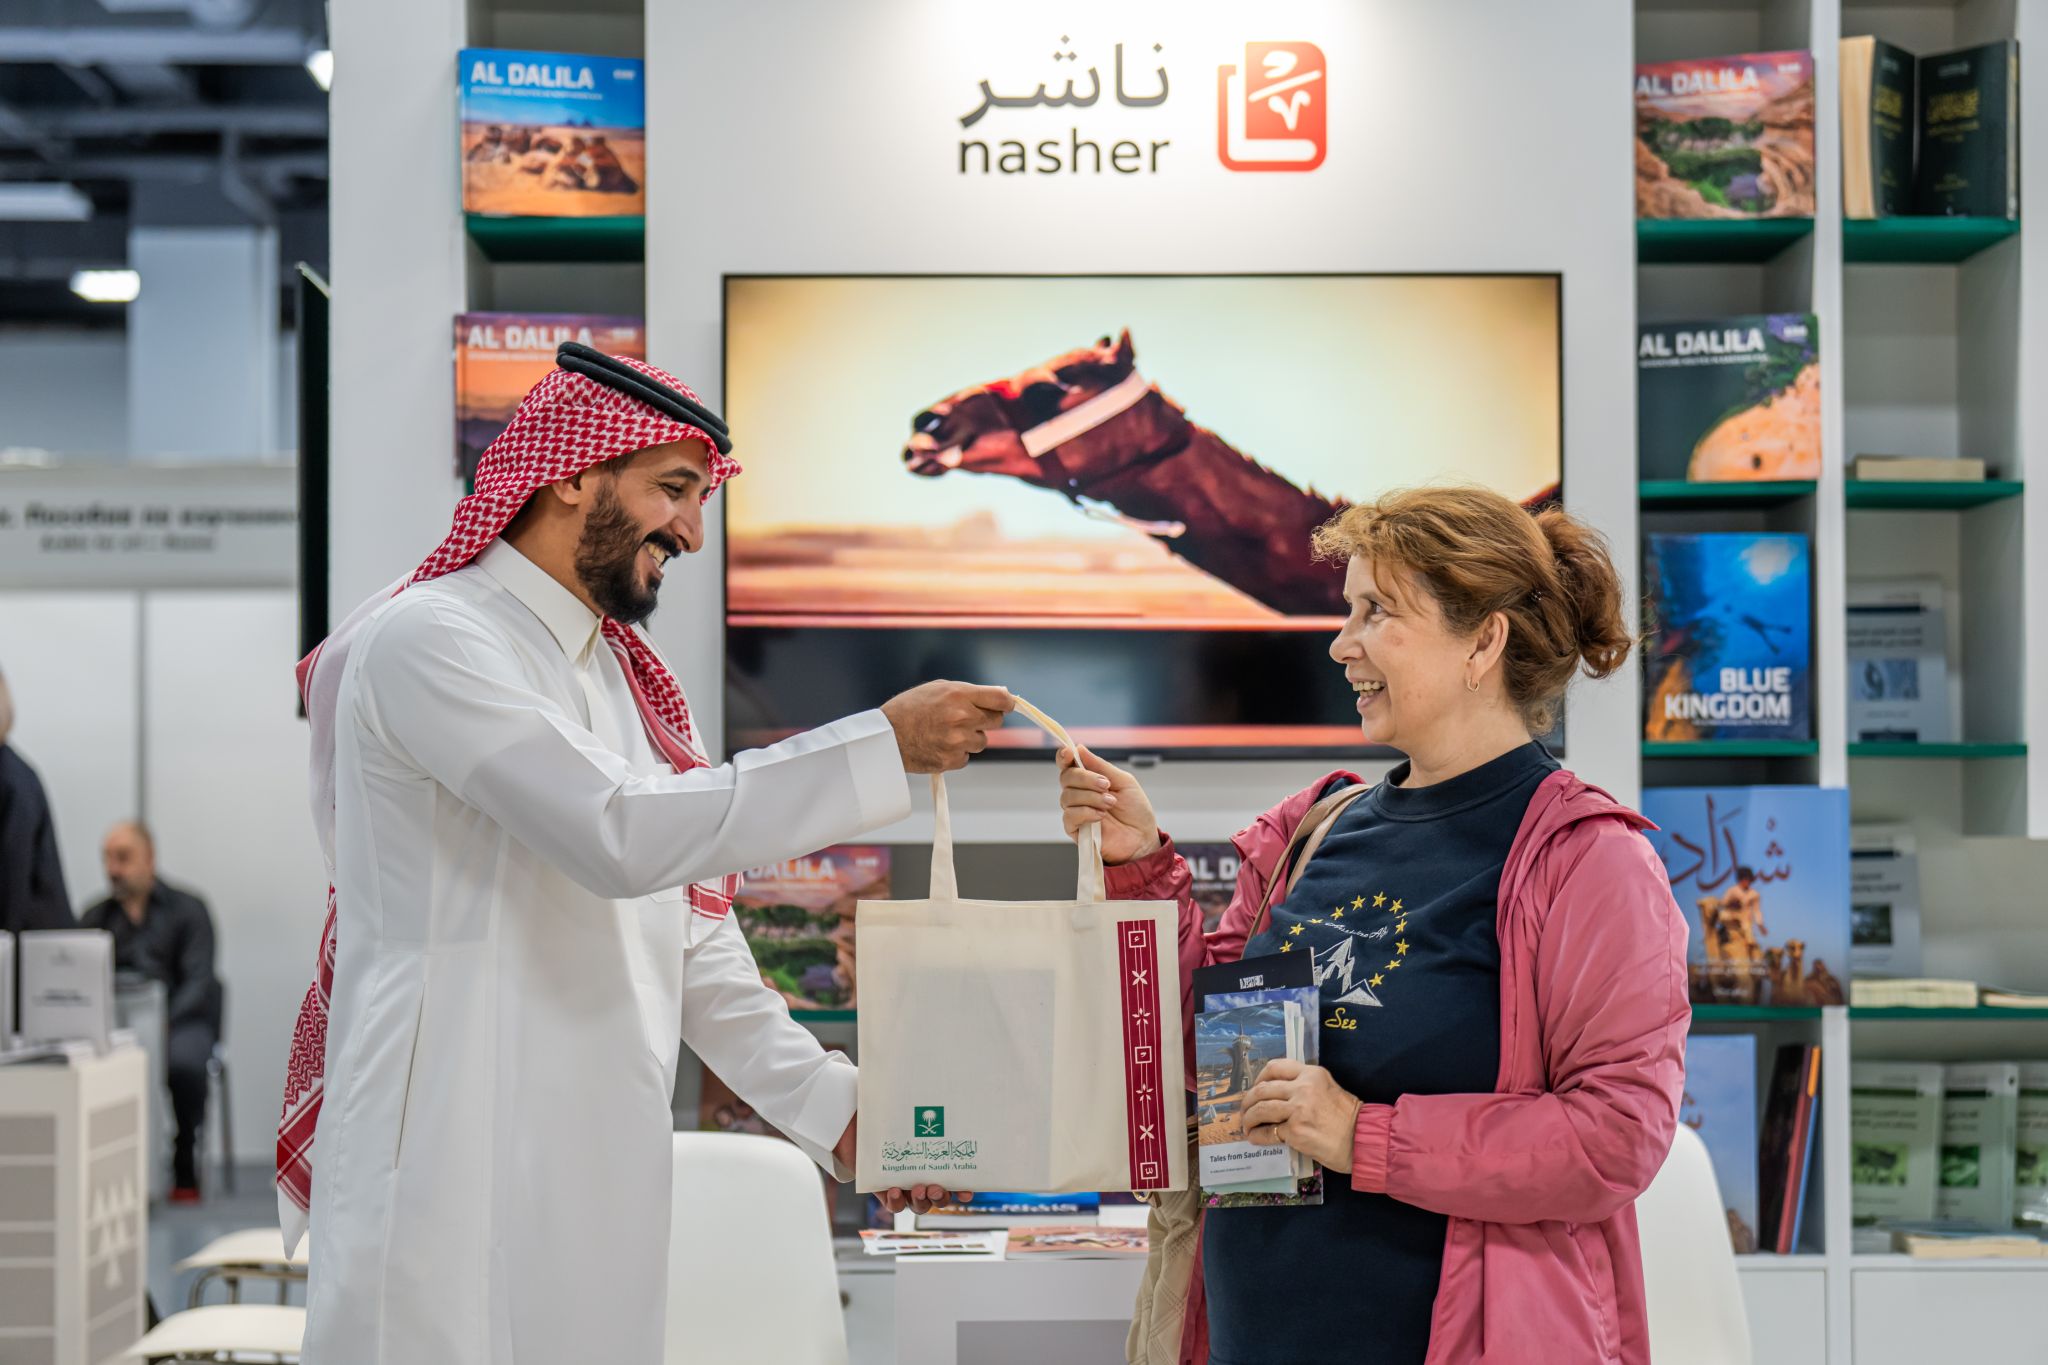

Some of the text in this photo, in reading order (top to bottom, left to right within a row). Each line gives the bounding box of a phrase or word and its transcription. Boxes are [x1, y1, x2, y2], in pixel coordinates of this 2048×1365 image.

[471, 61, 504, 85] AL
[507, 62, 595, 89] DALILA
[958, 34, 1169, 128] ناشر
[1636, 66, 1759, 96] AL DALILA
[958, 128, 1170, 174] nasher
[467, 325, 500, 350] AL
[1639, 333, 1671, 357] AL
[1675, 327, 1766, 356] DALILA
[1719, 667, 1792, 693] BLUE
[1664, 693, 1792, 720] KINGDOM
[1325, 1007, 1358, 1030] See
[882, 1162, 977, 1173] Kingdom of Saudi Arabia
[1209, 1147, 1283, 1163] Tales from Saudi Arabia
